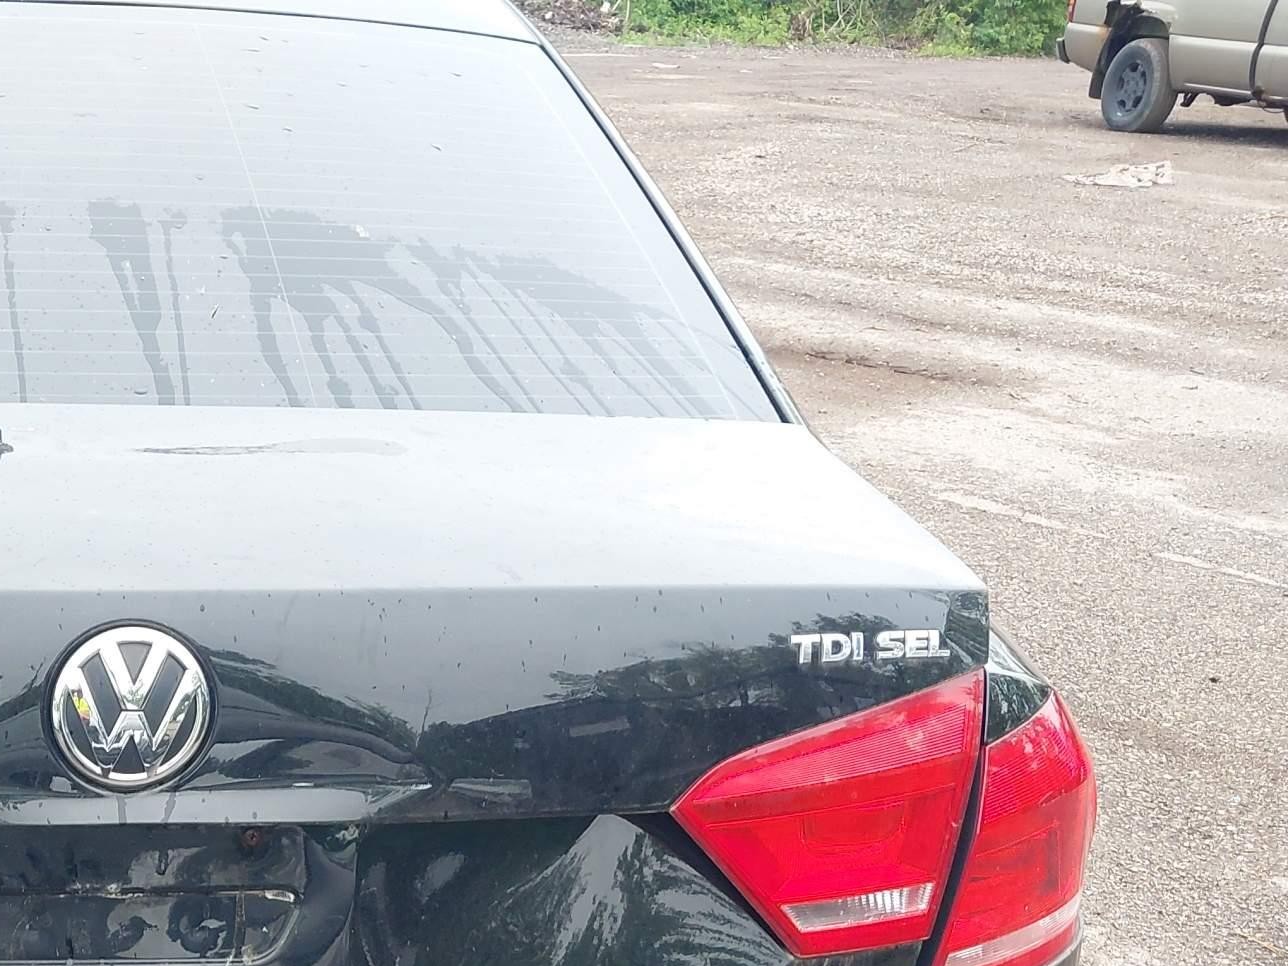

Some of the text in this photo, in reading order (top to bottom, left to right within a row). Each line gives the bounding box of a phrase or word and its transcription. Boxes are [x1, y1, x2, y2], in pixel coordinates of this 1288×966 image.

[790, 629, 951, 664] TDI SEL
[52, 625, 210, 783] VW
